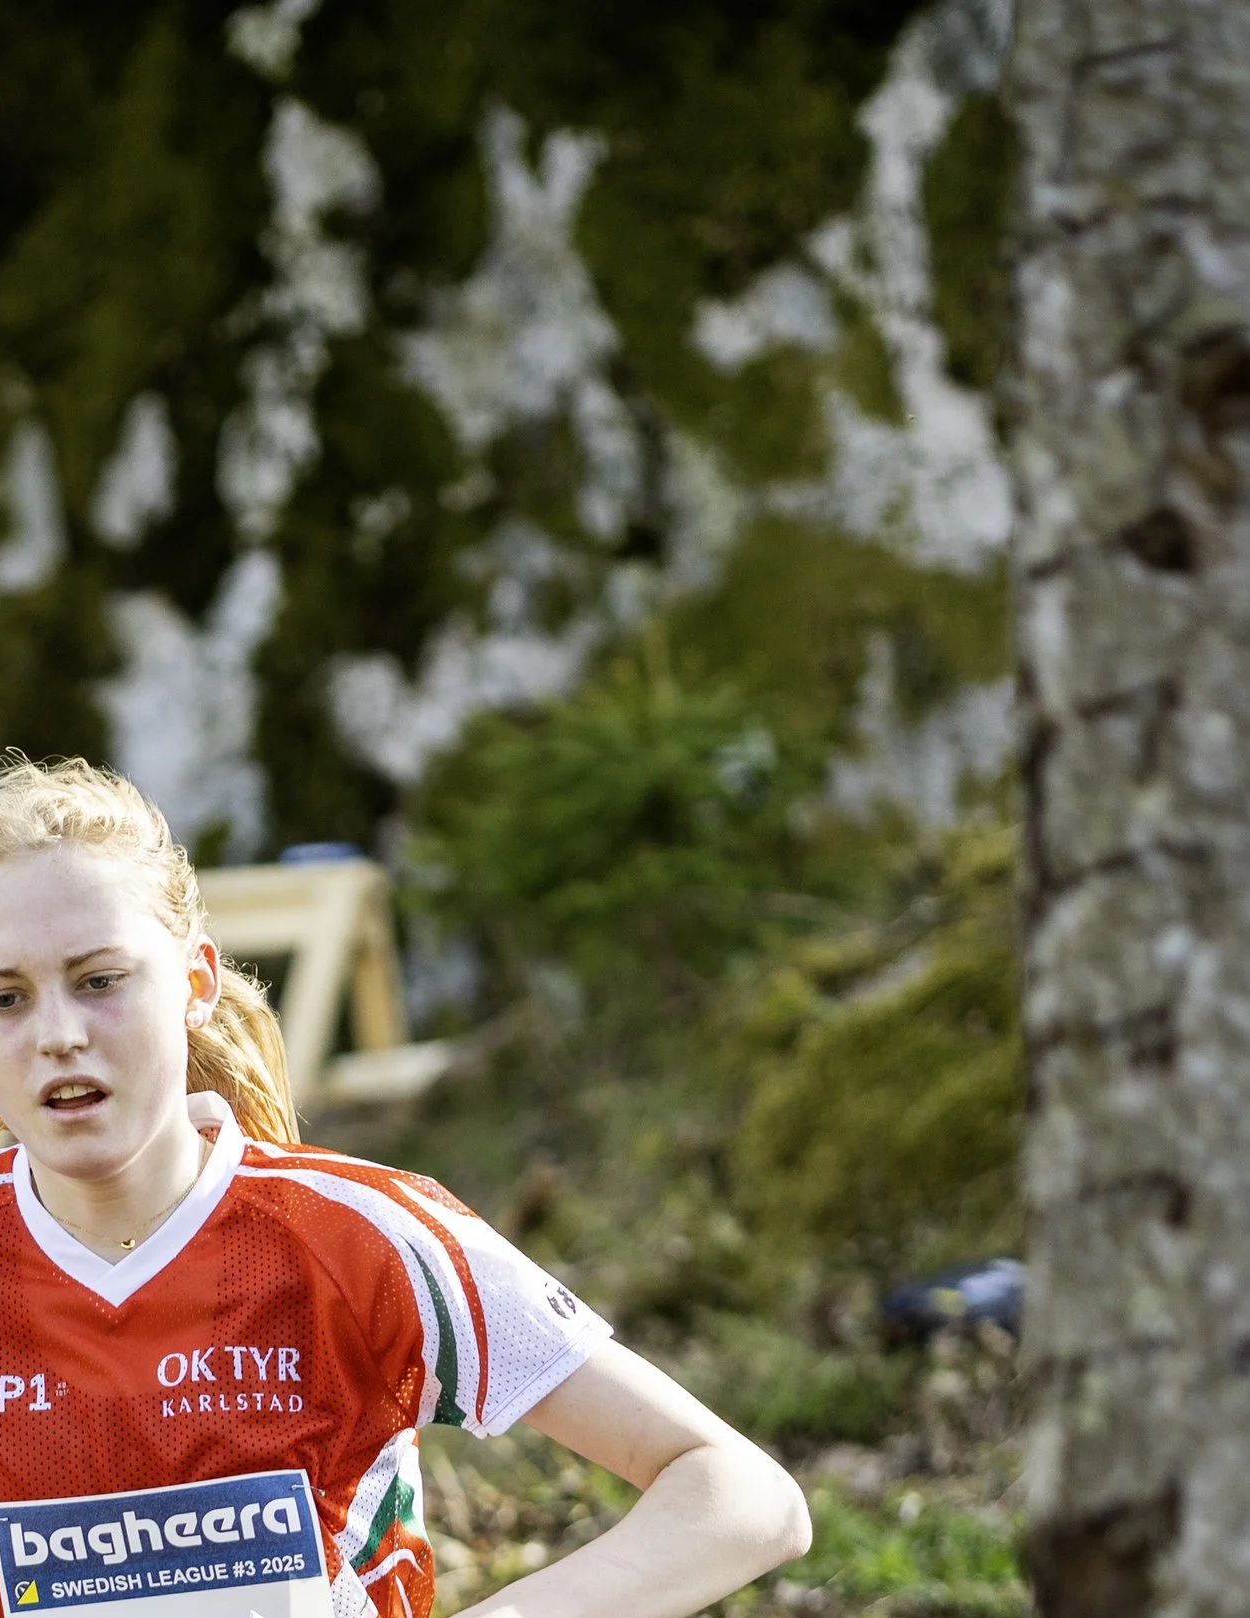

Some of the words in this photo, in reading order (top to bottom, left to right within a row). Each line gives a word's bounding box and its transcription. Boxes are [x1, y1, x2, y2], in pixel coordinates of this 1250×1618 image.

[157, 1347, 217, 1387] OK
[224, 1346, 302, 1381] TYR
[161, 1393, 303, 1418] KARLSTAD
[9, 1497, 302, 1567] bagheera
[51, 1573, 143, 1599] SWEDISH
[146, 1563, 229, 1588] LEAGUE
[232, 1560, 257, 1578] #3
[260, 1554, 306, 1575] 2025
